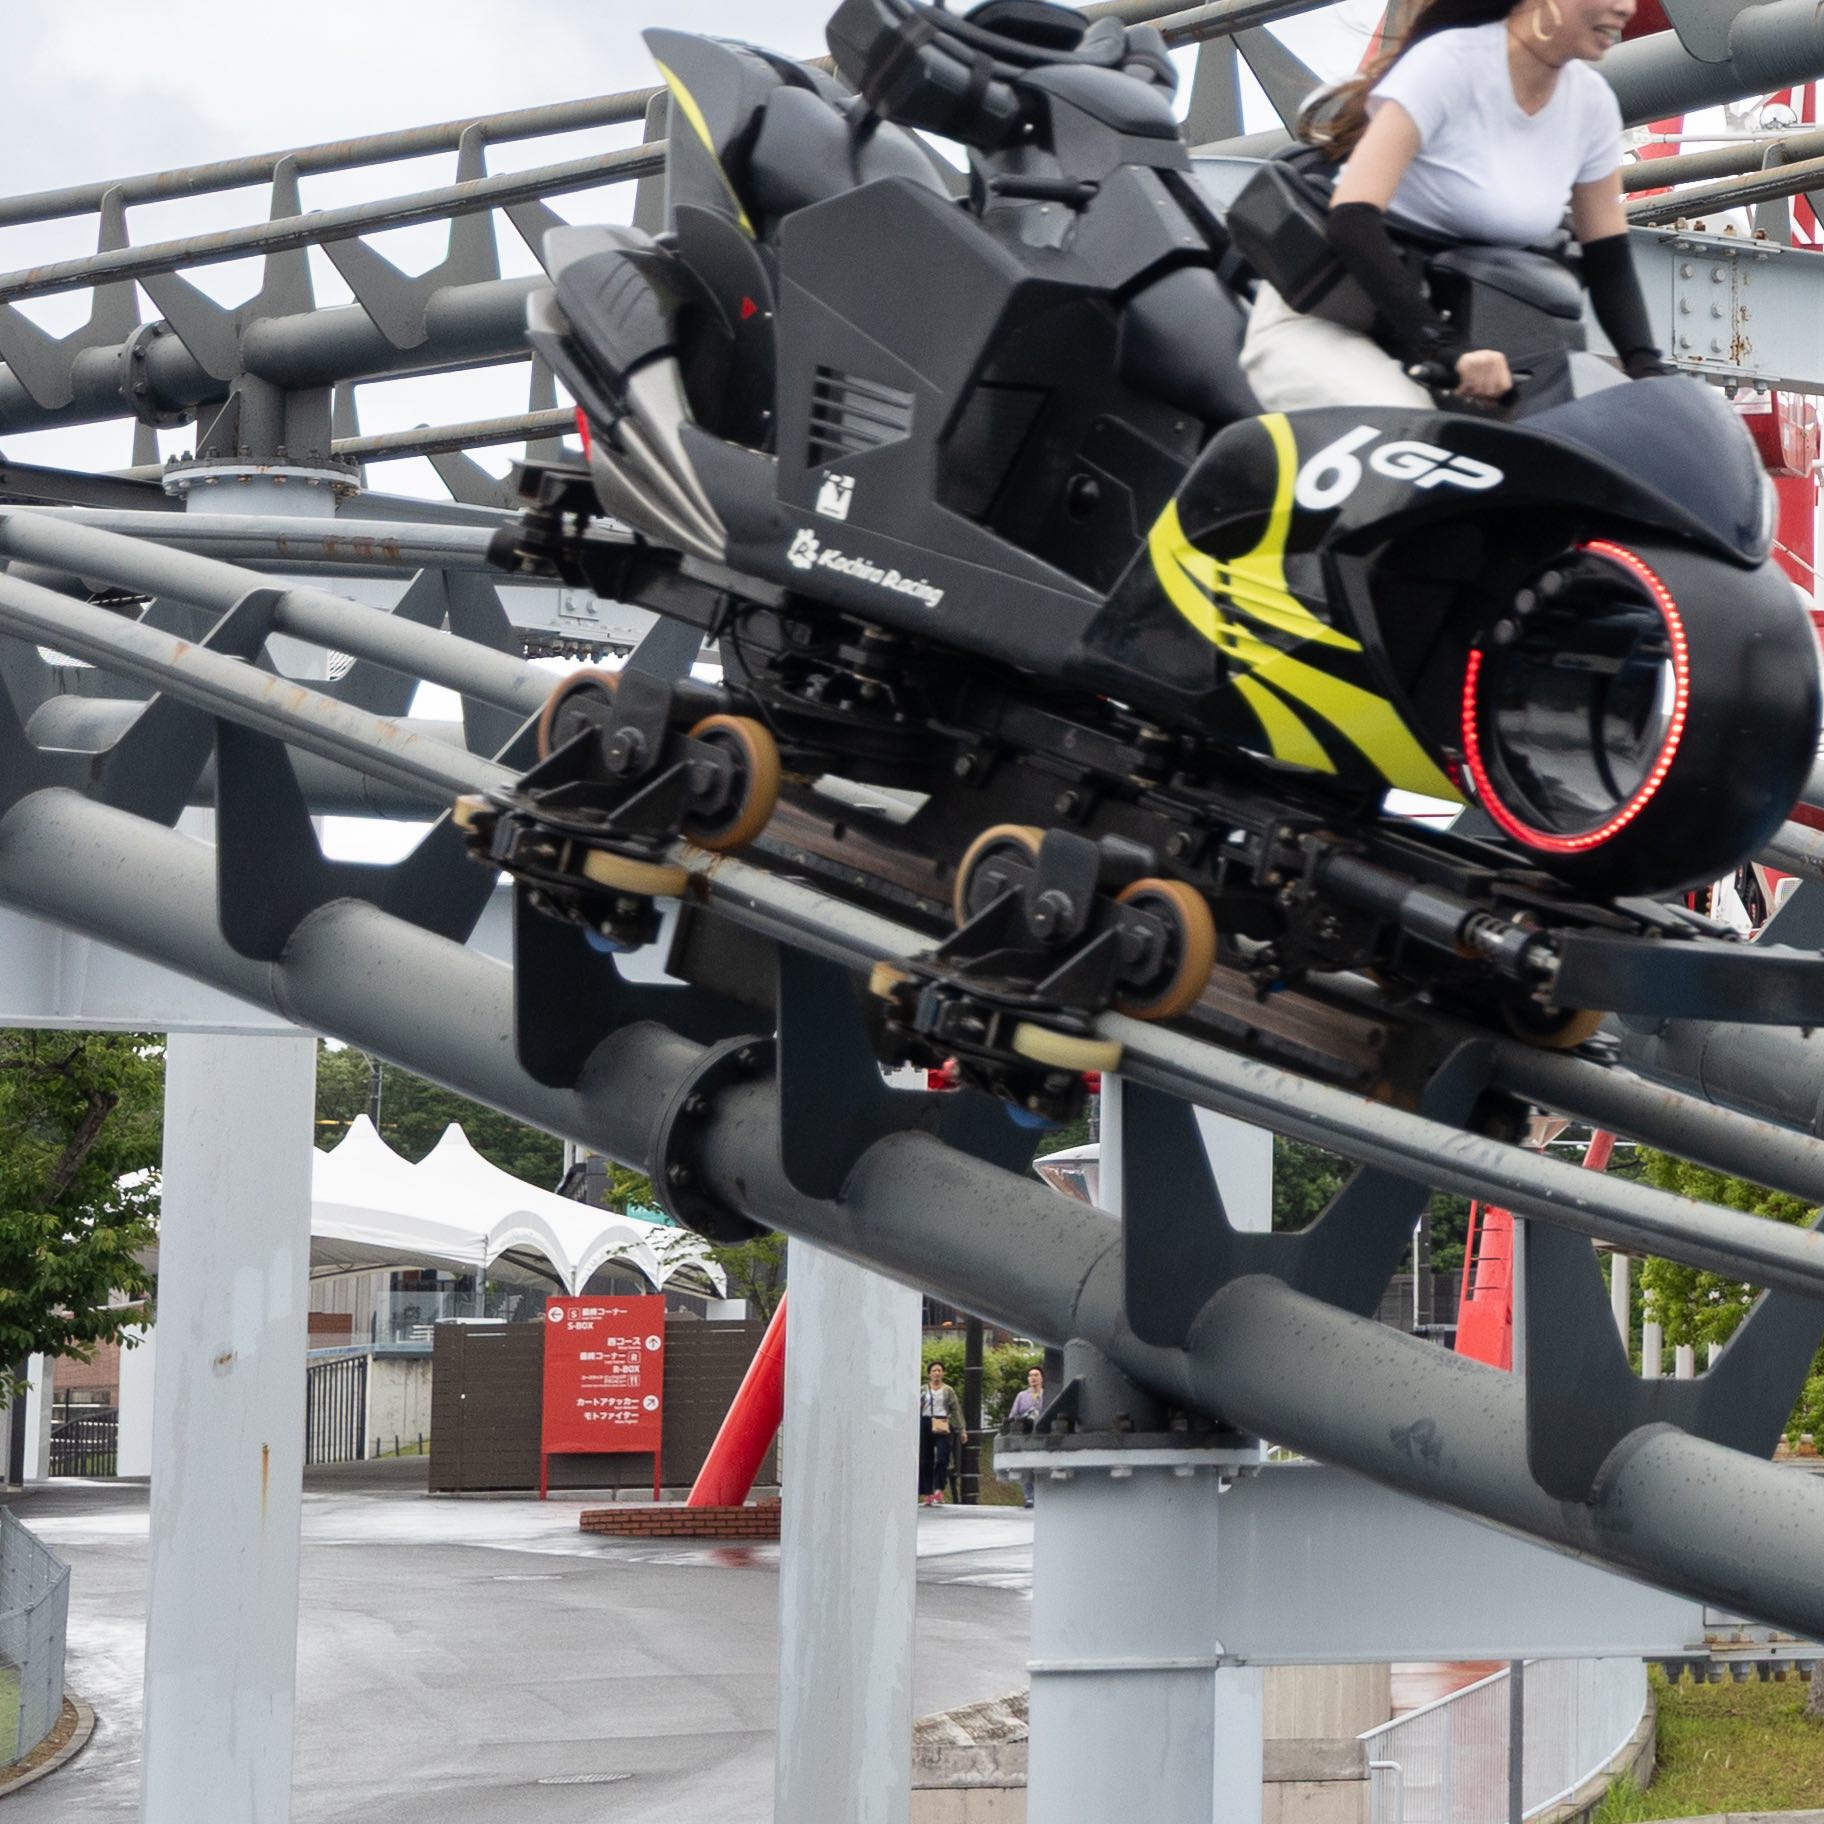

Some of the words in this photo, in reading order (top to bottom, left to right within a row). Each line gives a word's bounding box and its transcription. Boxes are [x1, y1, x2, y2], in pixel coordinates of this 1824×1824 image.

[1296, 424, 1382, 510] 6
[1370, 440, 1505, 490] GP
[881, 569, 945, 608] Racing
[567, 1322, 594, 1330] S-BOX
[613, 1365, 640, 1373] R-BOX
[577, 1398, 640, 1407] カートアタッカー
[584, 1412, 640, 1420] モトファイター
